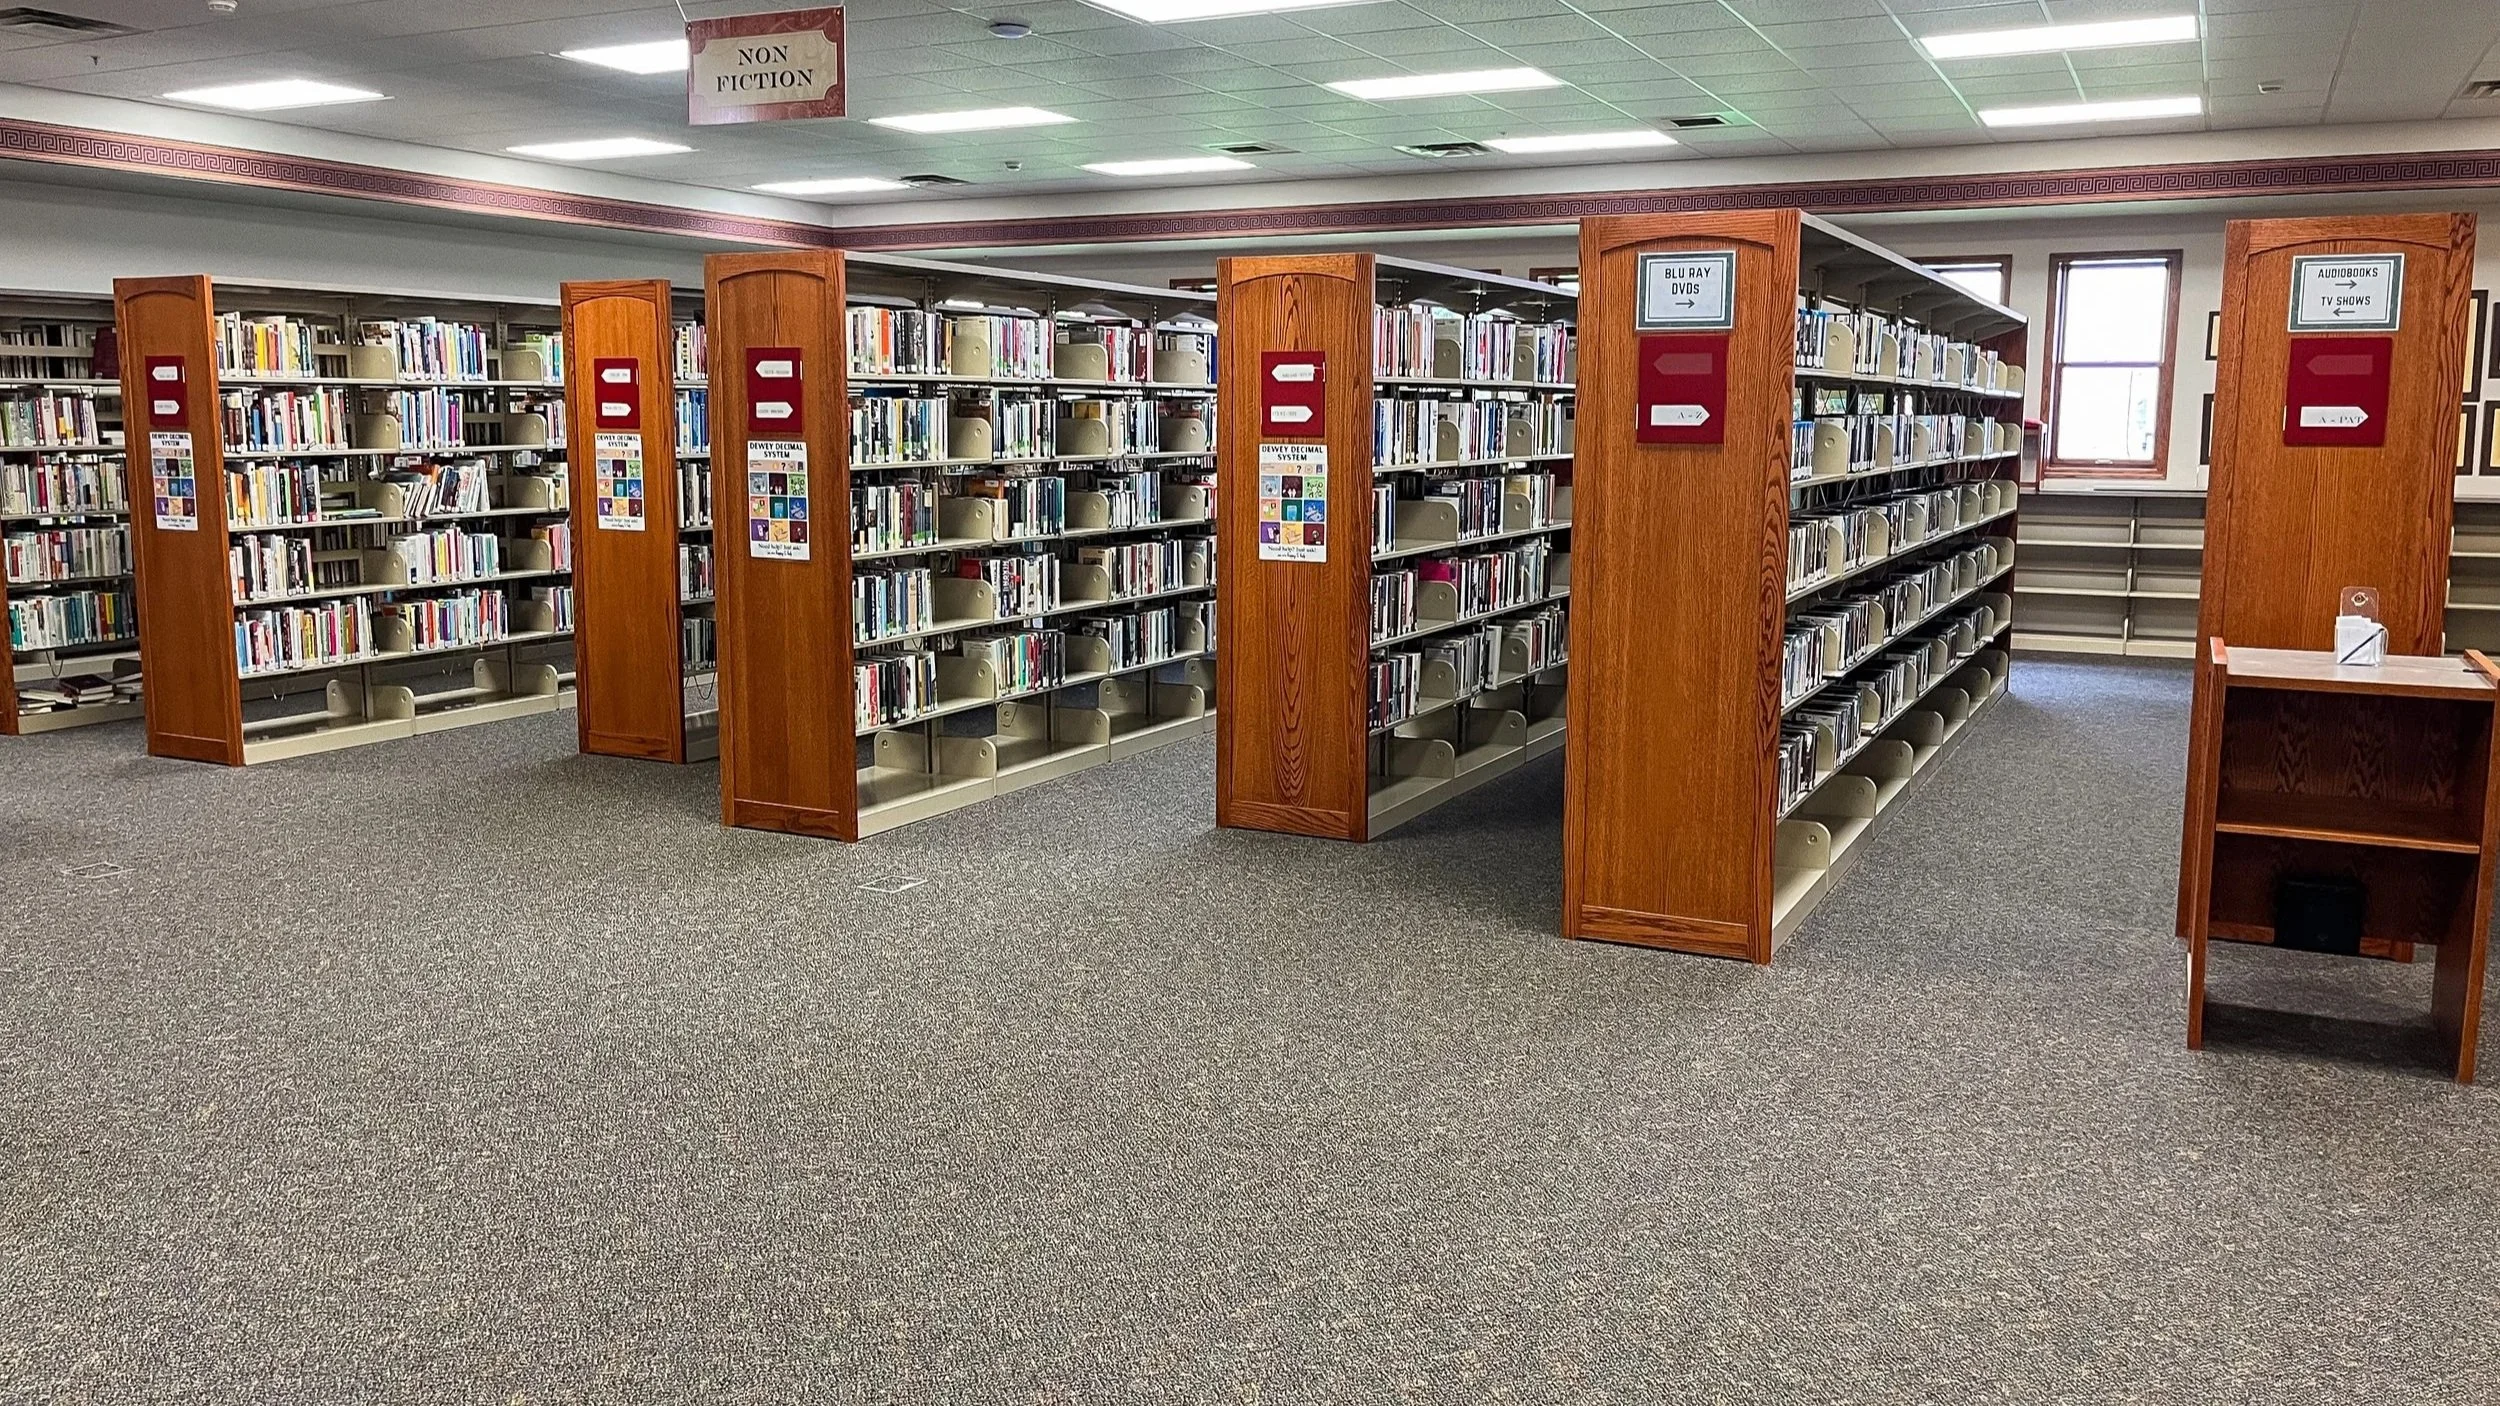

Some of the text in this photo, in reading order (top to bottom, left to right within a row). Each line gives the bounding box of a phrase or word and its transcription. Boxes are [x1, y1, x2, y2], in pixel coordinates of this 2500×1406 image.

[737, 45, 789, 66] NON
[717, 69, 814, 93] FICTION
[1664, 267, 1711, 280] BLU RAY
[2317, 267, 2379, 279] AUDIOBOOKS
[2321, 295, 2371, 307] TV SHOWS
